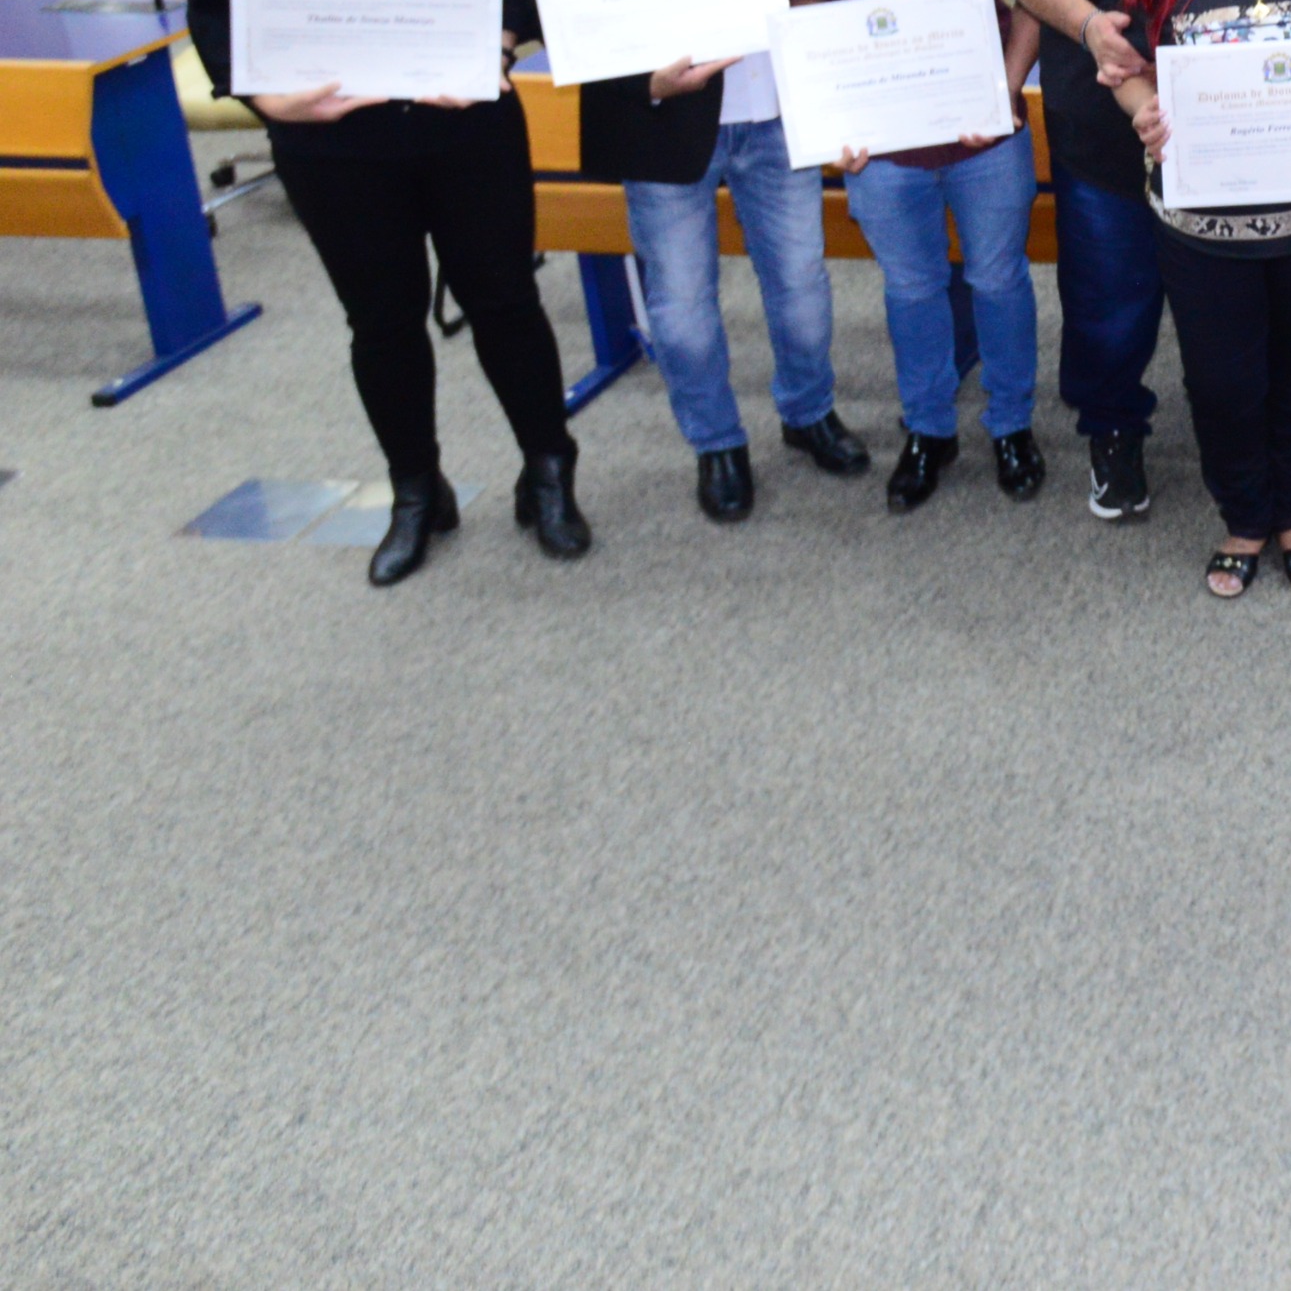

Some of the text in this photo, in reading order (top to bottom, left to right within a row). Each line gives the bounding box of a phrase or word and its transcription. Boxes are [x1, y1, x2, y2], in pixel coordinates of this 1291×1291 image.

[1197, 89, 1246, 103] Diploma
[1250, 88, 1261, 97] de
[1230, 126, 1264, 136] Rogério
